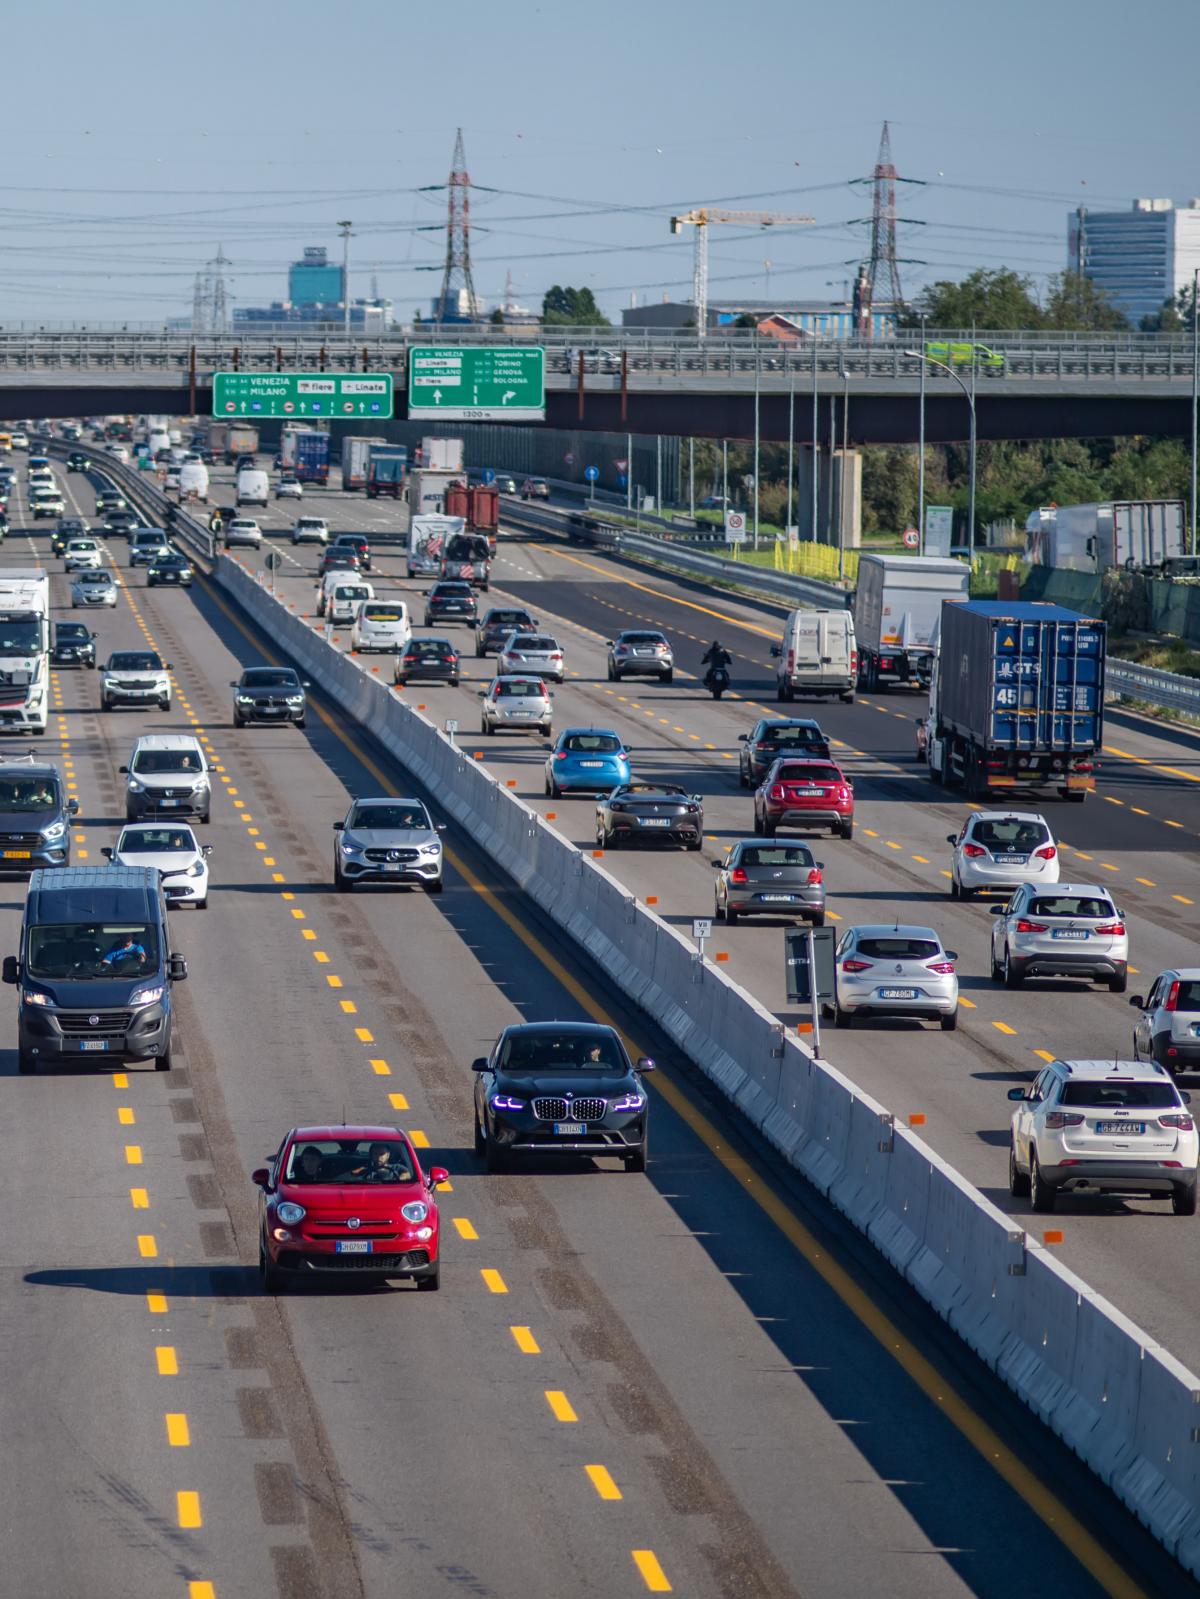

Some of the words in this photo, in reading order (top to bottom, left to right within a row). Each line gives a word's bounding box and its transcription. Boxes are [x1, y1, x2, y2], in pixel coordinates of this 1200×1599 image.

[250, 378, 290, 386] VENEZIA
[250, 387, 287, 396] MILANO
[355, 383, 384, 391] Linate
[1012, 662, 1042, 674] GTS
[996, 688, 1017, 704] 45
